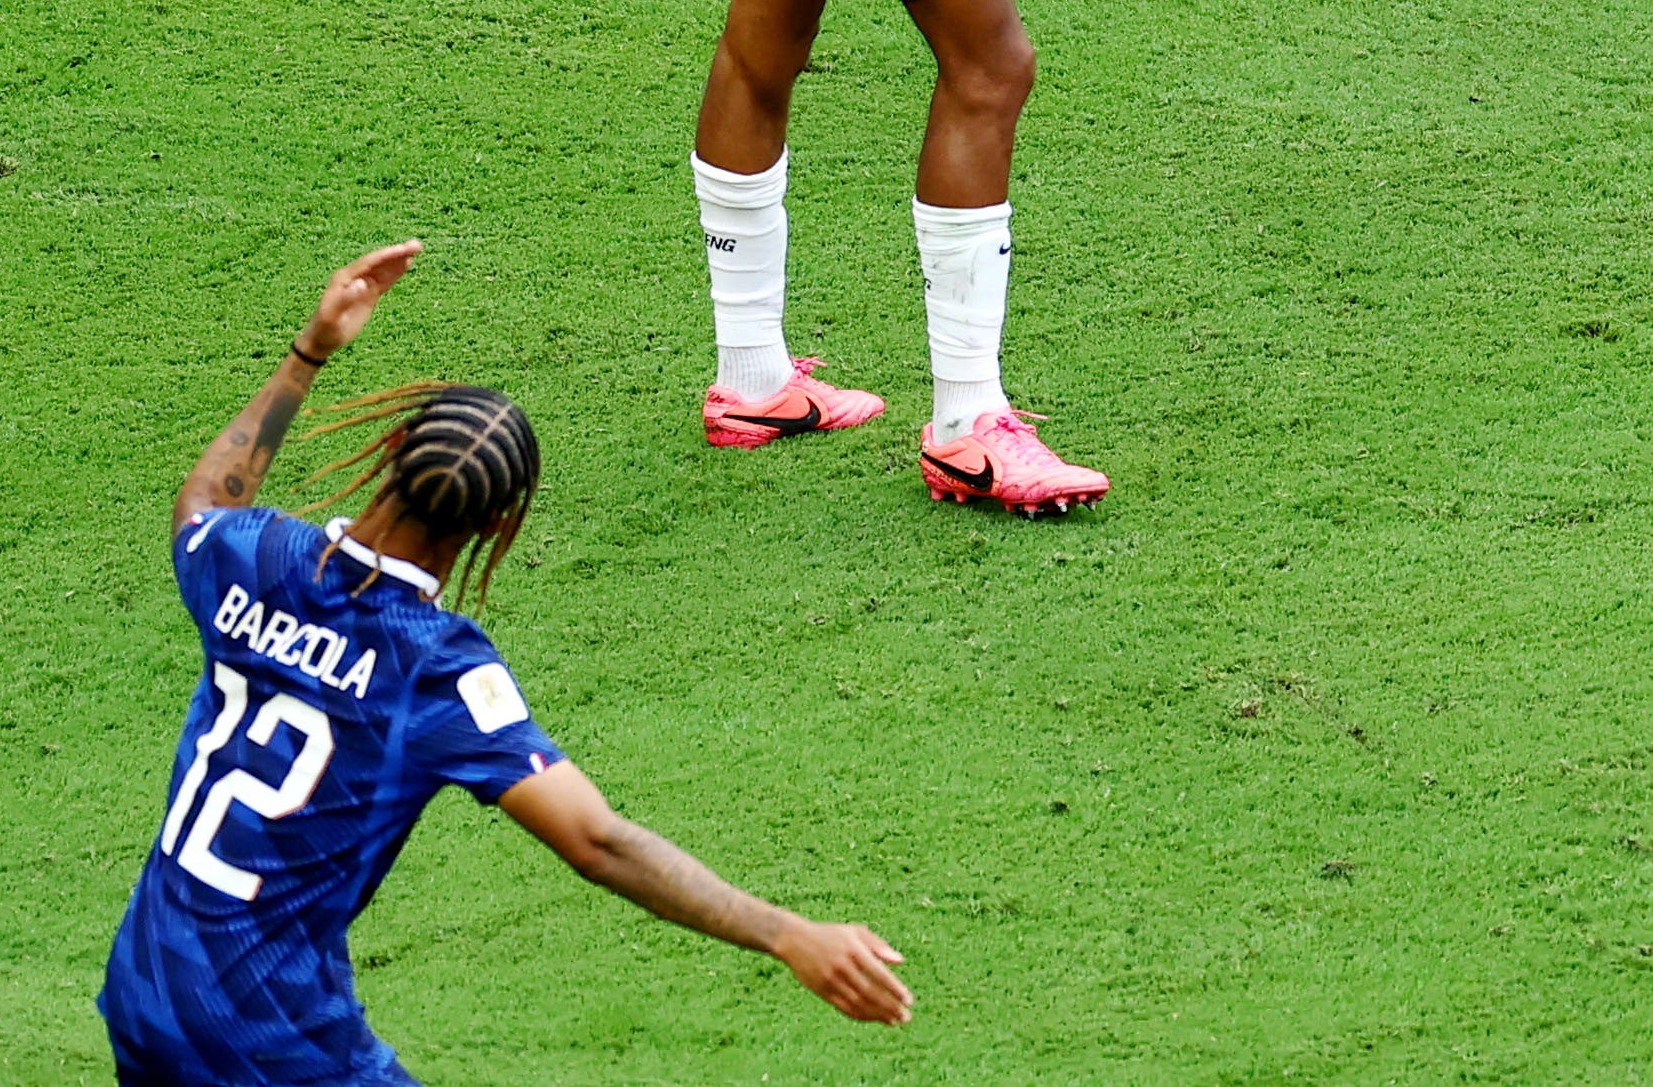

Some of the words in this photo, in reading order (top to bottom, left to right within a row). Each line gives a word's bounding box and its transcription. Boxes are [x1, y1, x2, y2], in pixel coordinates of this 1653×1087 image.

[705, 232, 737, 253] ENG
[213, 583, 377, 699] BARCOLA
[160, 660, 336, 902] 12
